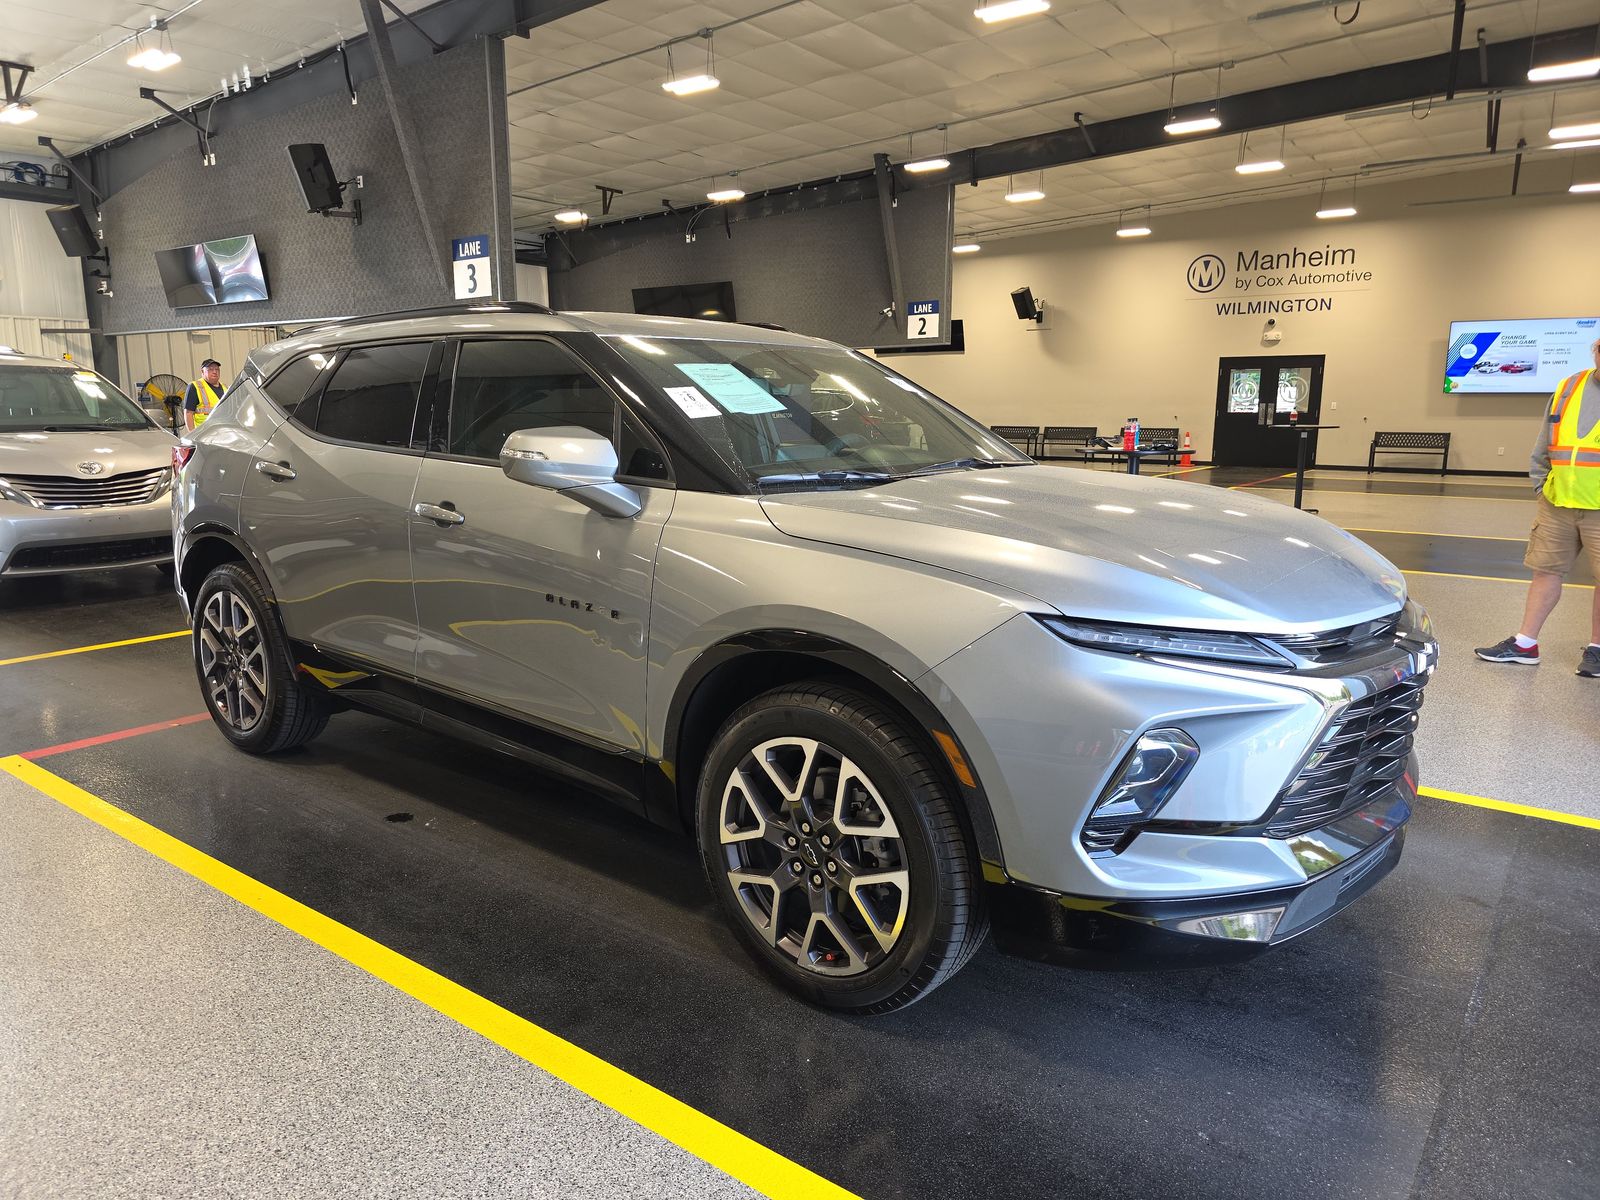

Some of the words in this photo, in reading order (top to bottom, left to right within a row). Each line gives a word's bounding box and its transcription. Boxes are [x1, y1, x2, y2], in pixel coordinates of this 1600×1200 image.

[459, 241, 481, 257] LANE
[1236, 244, 1356, 272] Manheim
[467, 263, 477, 293] 3
[1235, 276, 1252, 291] by
[1256, 275, 1284, 288] Cox
[1287, 271, 1373, 286] Automotive
[914, 303, 933, 314] LANE
[1216, 297, 1333, 316] WILMINGTON
[917, 317, 927, 336] 2
